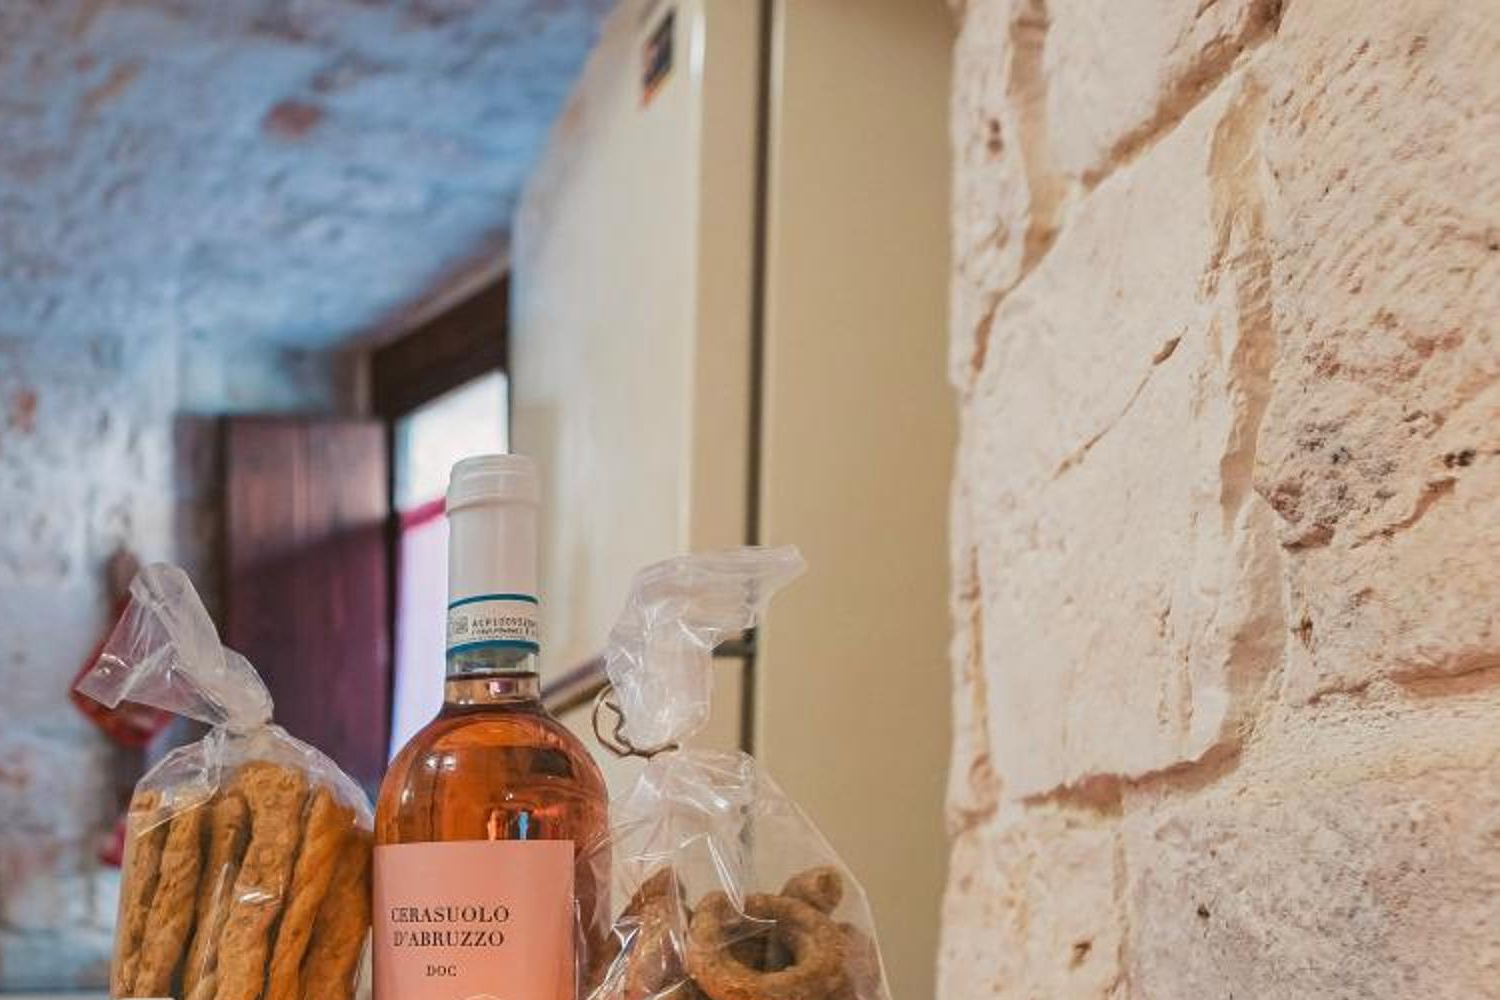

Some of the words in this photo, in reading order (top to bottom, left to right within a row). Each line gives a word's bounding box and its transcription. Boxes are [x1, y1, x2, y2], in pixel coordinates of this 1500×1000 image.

[390, 905, 510, 923] CERASUOLO
[393, 930, 505, 947] D'ABRUZZO
[425, 965, 457, 977] DOC
